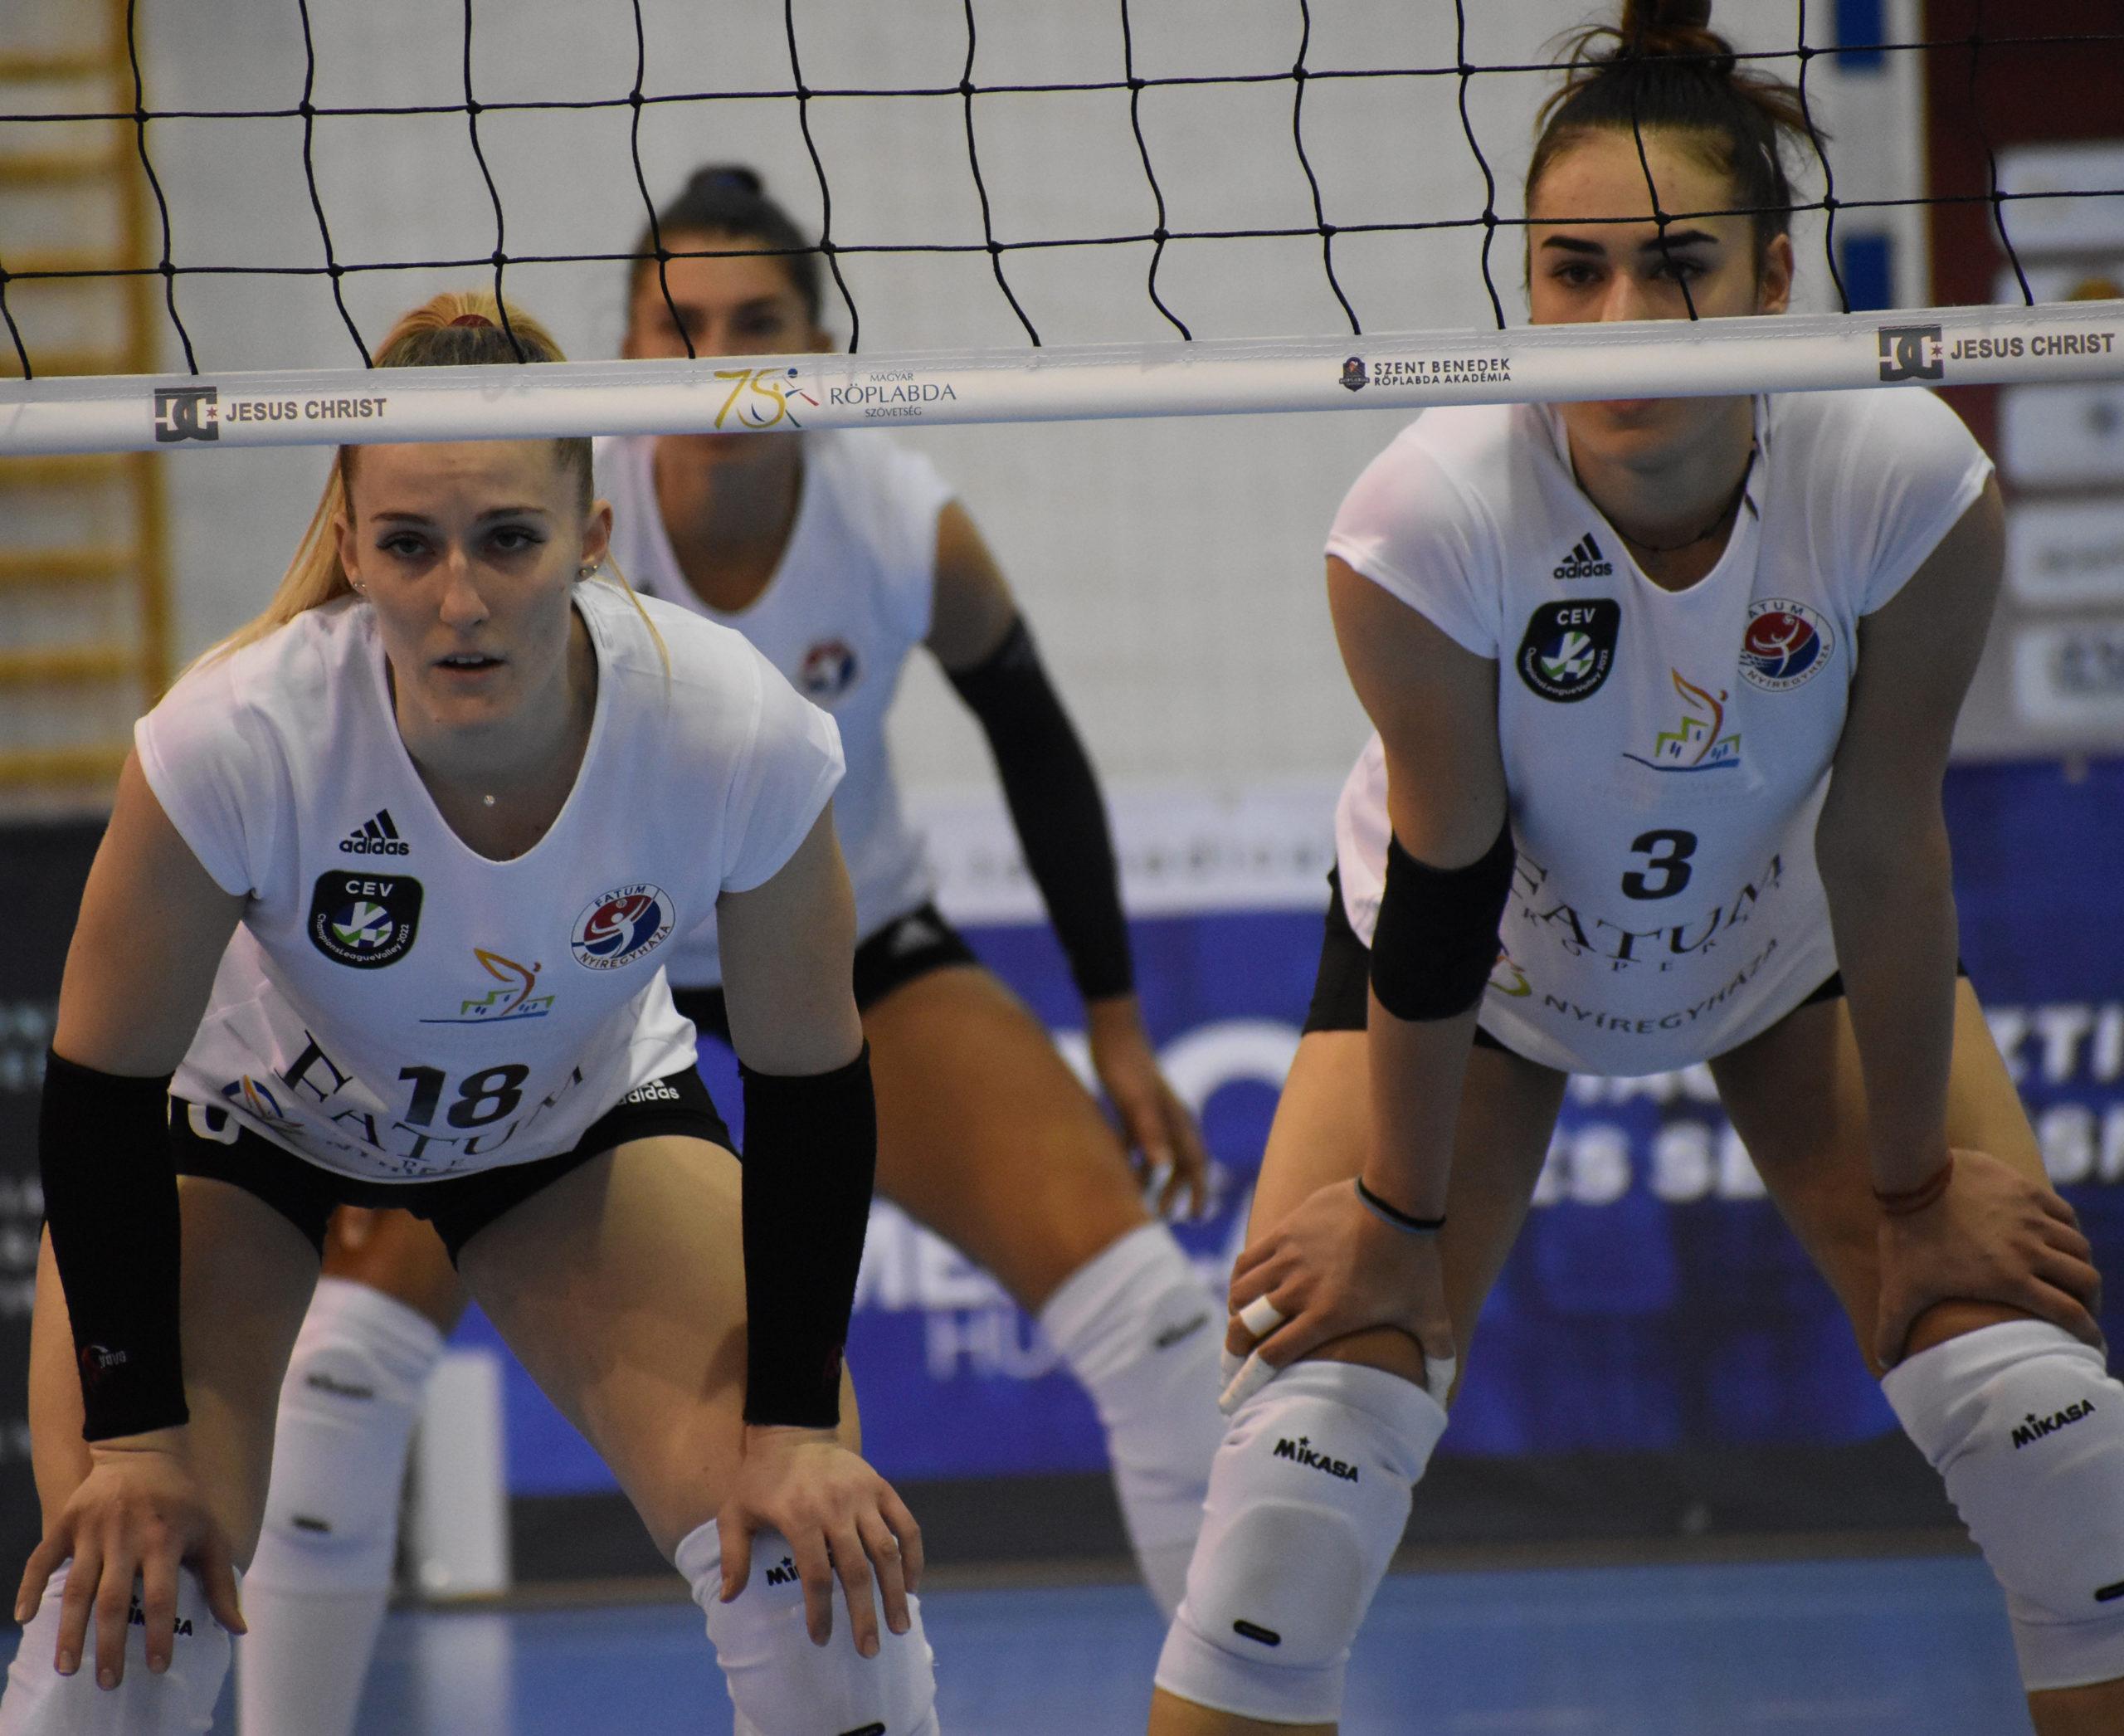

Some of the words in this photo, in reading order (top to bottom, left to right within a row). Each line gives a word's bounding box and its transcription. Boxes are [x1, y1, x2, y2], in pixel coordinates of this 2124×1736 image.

[1951, 337, 2024, 360] JESUS
[2031, 333, 2116, 356] CHRIST
[1374, 361, 1426, 376] SZENT
[1431, 358, 1511, 373] BENEDEK
[870, 373, 914, 383] MAGYAR
[1374, 373, 1440, 387] RÖPLABDA
[1444, 370, 1512, 383] AKADÉMIA
[831, 383, 957, 405] RÖPLABDA
[225, 402, 298, 422] JESUS
[304, 397, 387, 420] CHRIST
[1553, 561, 1612, 579] adidas
[1556, 607, 1595, 626] CEV
[1748, 601, 1804, 619] ATUM
[339, 836, 410, 856] adidas
[1621, 828, 1698, 900] 3
[345, 880, 394, 897] CEV
[594, 885, 646, 908] FATUM
[398, 924, 410, 944] 2022
[397, 1064, 530, 1129] 18
